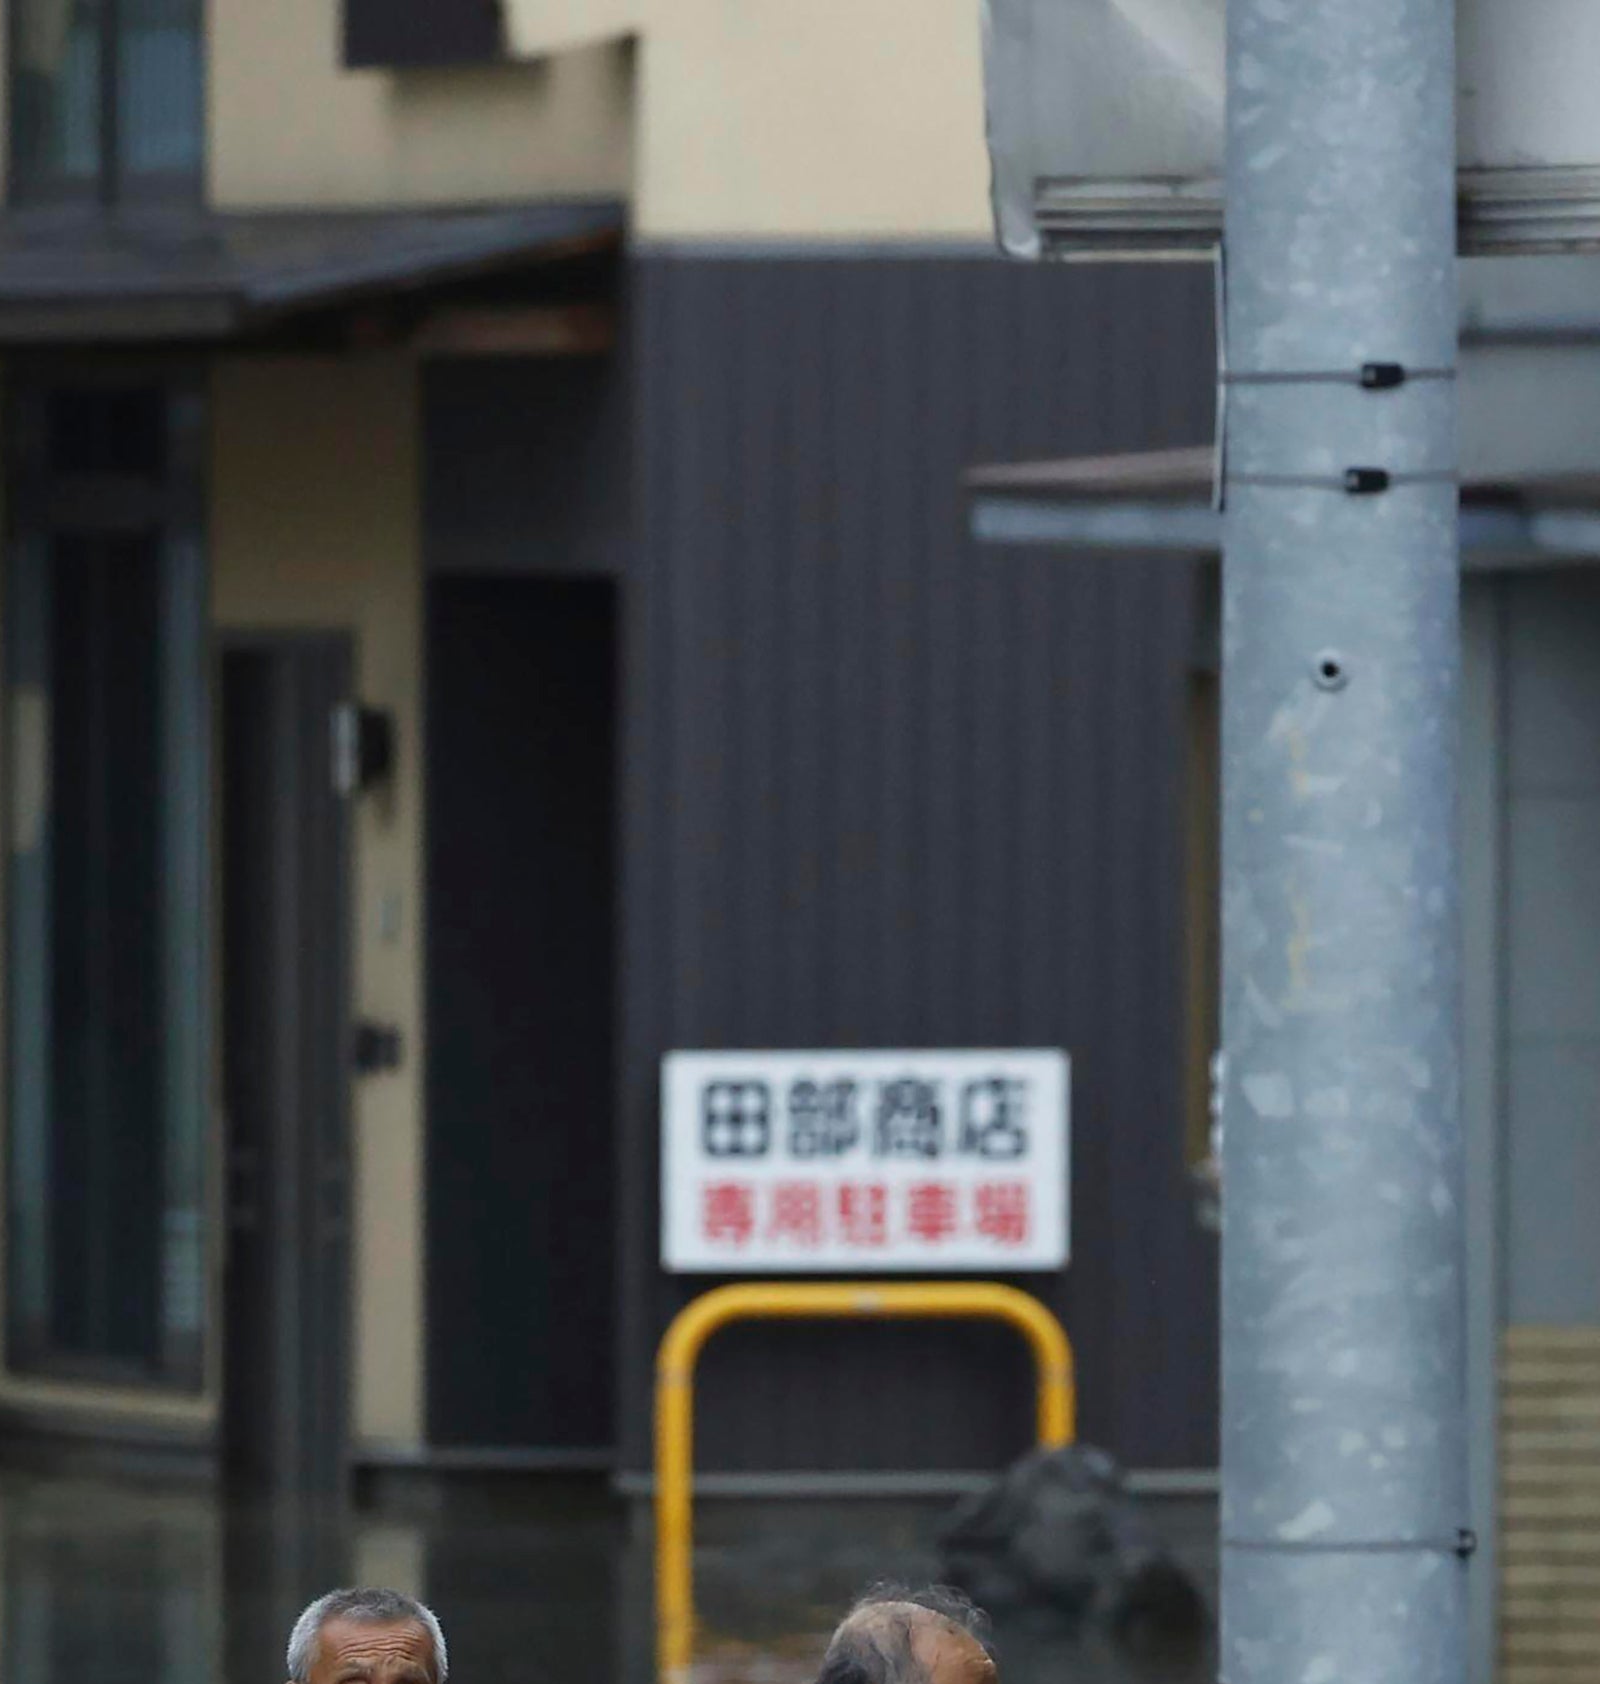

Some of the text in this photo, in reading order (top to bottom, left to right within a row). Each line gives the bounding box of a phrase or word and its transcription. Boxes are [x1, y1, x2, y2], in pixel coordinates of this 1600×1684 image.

[704, 1074, 1031, 1159] 田部商店
[703, 1181, 1030, 1247] 専用駐車場
